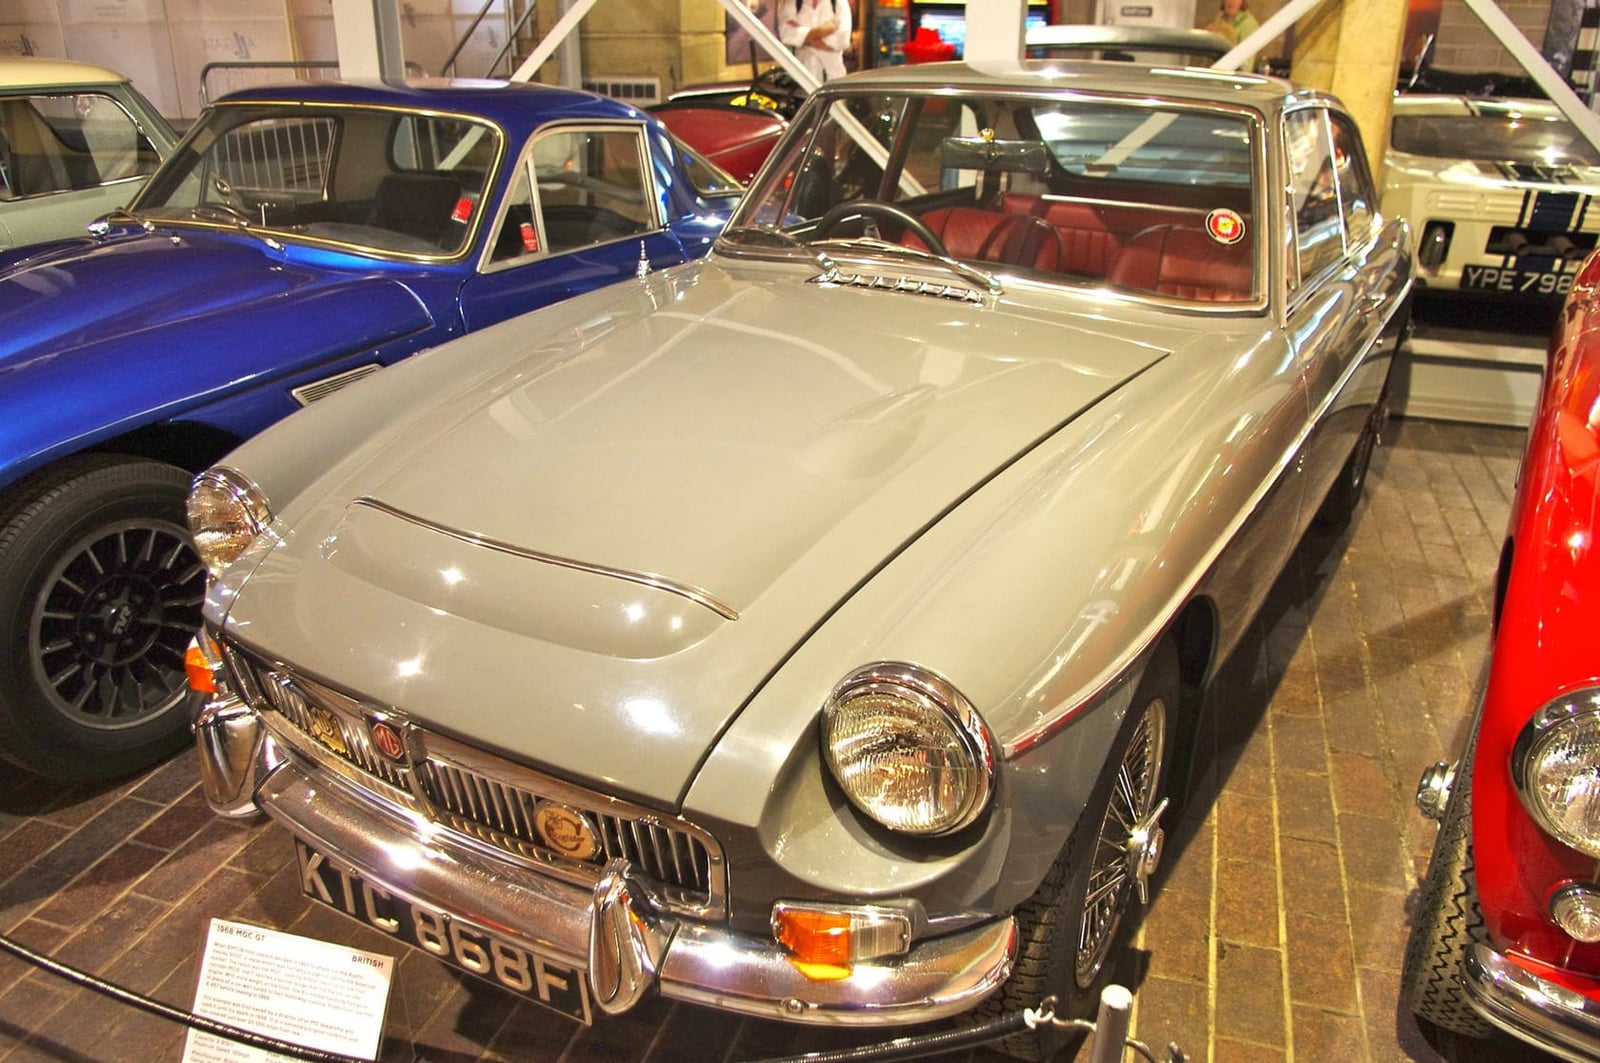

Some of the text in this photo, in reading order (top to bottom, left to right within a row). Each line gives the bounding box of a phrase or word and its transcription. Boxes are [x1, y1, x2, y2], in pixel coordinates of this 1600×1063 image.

[1467, 267, 1574, 294] YPE 798
[375, 727, 400, 756] MG
[217, 925, 266, 942] 1968 MGC GT
[302, 845, 399, 933] KTC
[411, 904, 568, 1002] 868F
[351, 955, 384, 968] BRITISH
